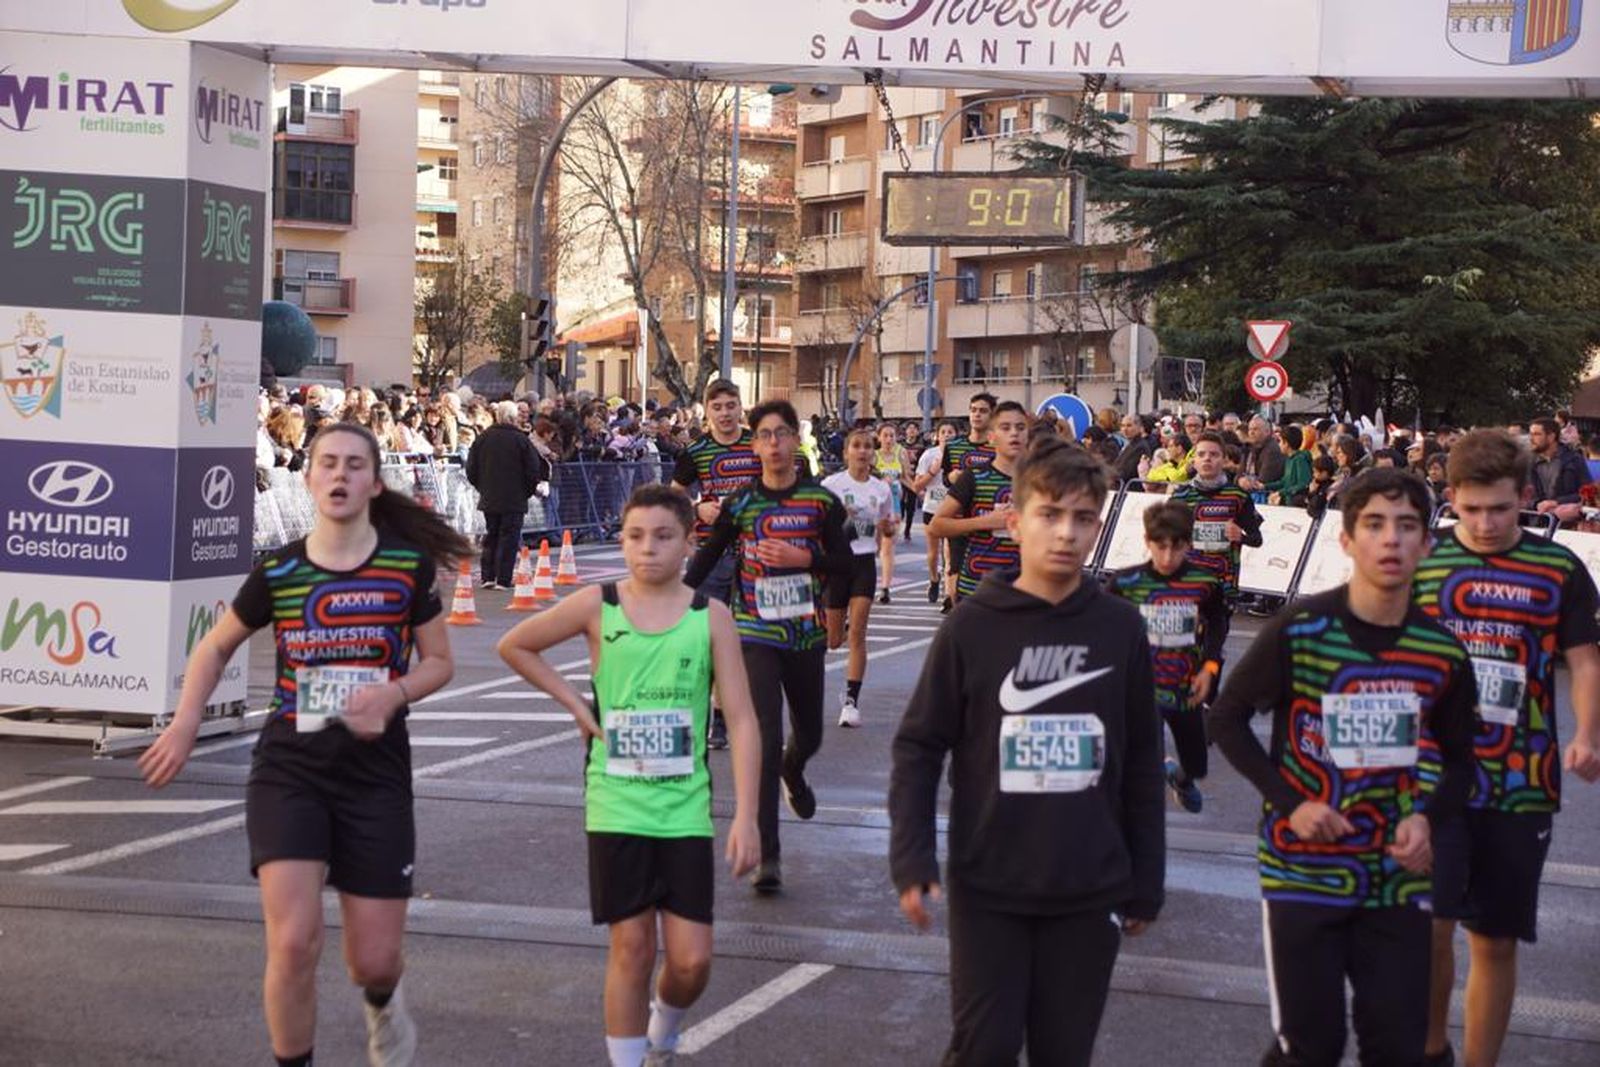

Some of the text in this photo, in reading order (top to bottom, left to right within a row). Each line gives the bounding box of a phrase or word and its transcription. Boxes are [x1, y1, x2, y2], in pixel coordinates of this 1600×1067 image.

[810, 34, 1126, 67] SALMANTINA
[79, 117, 166, 135] fertilizantes
[967, 188, 1064, 226] 9:01
[68, 361, 170, 380] San Estanislao
[1254, 375, 1278, 389] 30
[67, 377, 137, 395] de Kostka
[7, 511, 130, 537] HYUNDAI
[192, 516, 240, 538] HYUNDAI
[6, 534, 128, 561] Gestorauto
[191, 540, 238, 561] Gestorauto
[330, 591, 385, 608] XXXVIII
[1472, 581, 1532, 604] XXXVIII
[307, 626, 386, 644] SILVESTRE
[1014, 645, 1089, 683] NIKE
[1336, 713, 1398, 743] 5562
[617, 728, 674, 755] 5536
[1014, 736, 1080, 766] 5549
